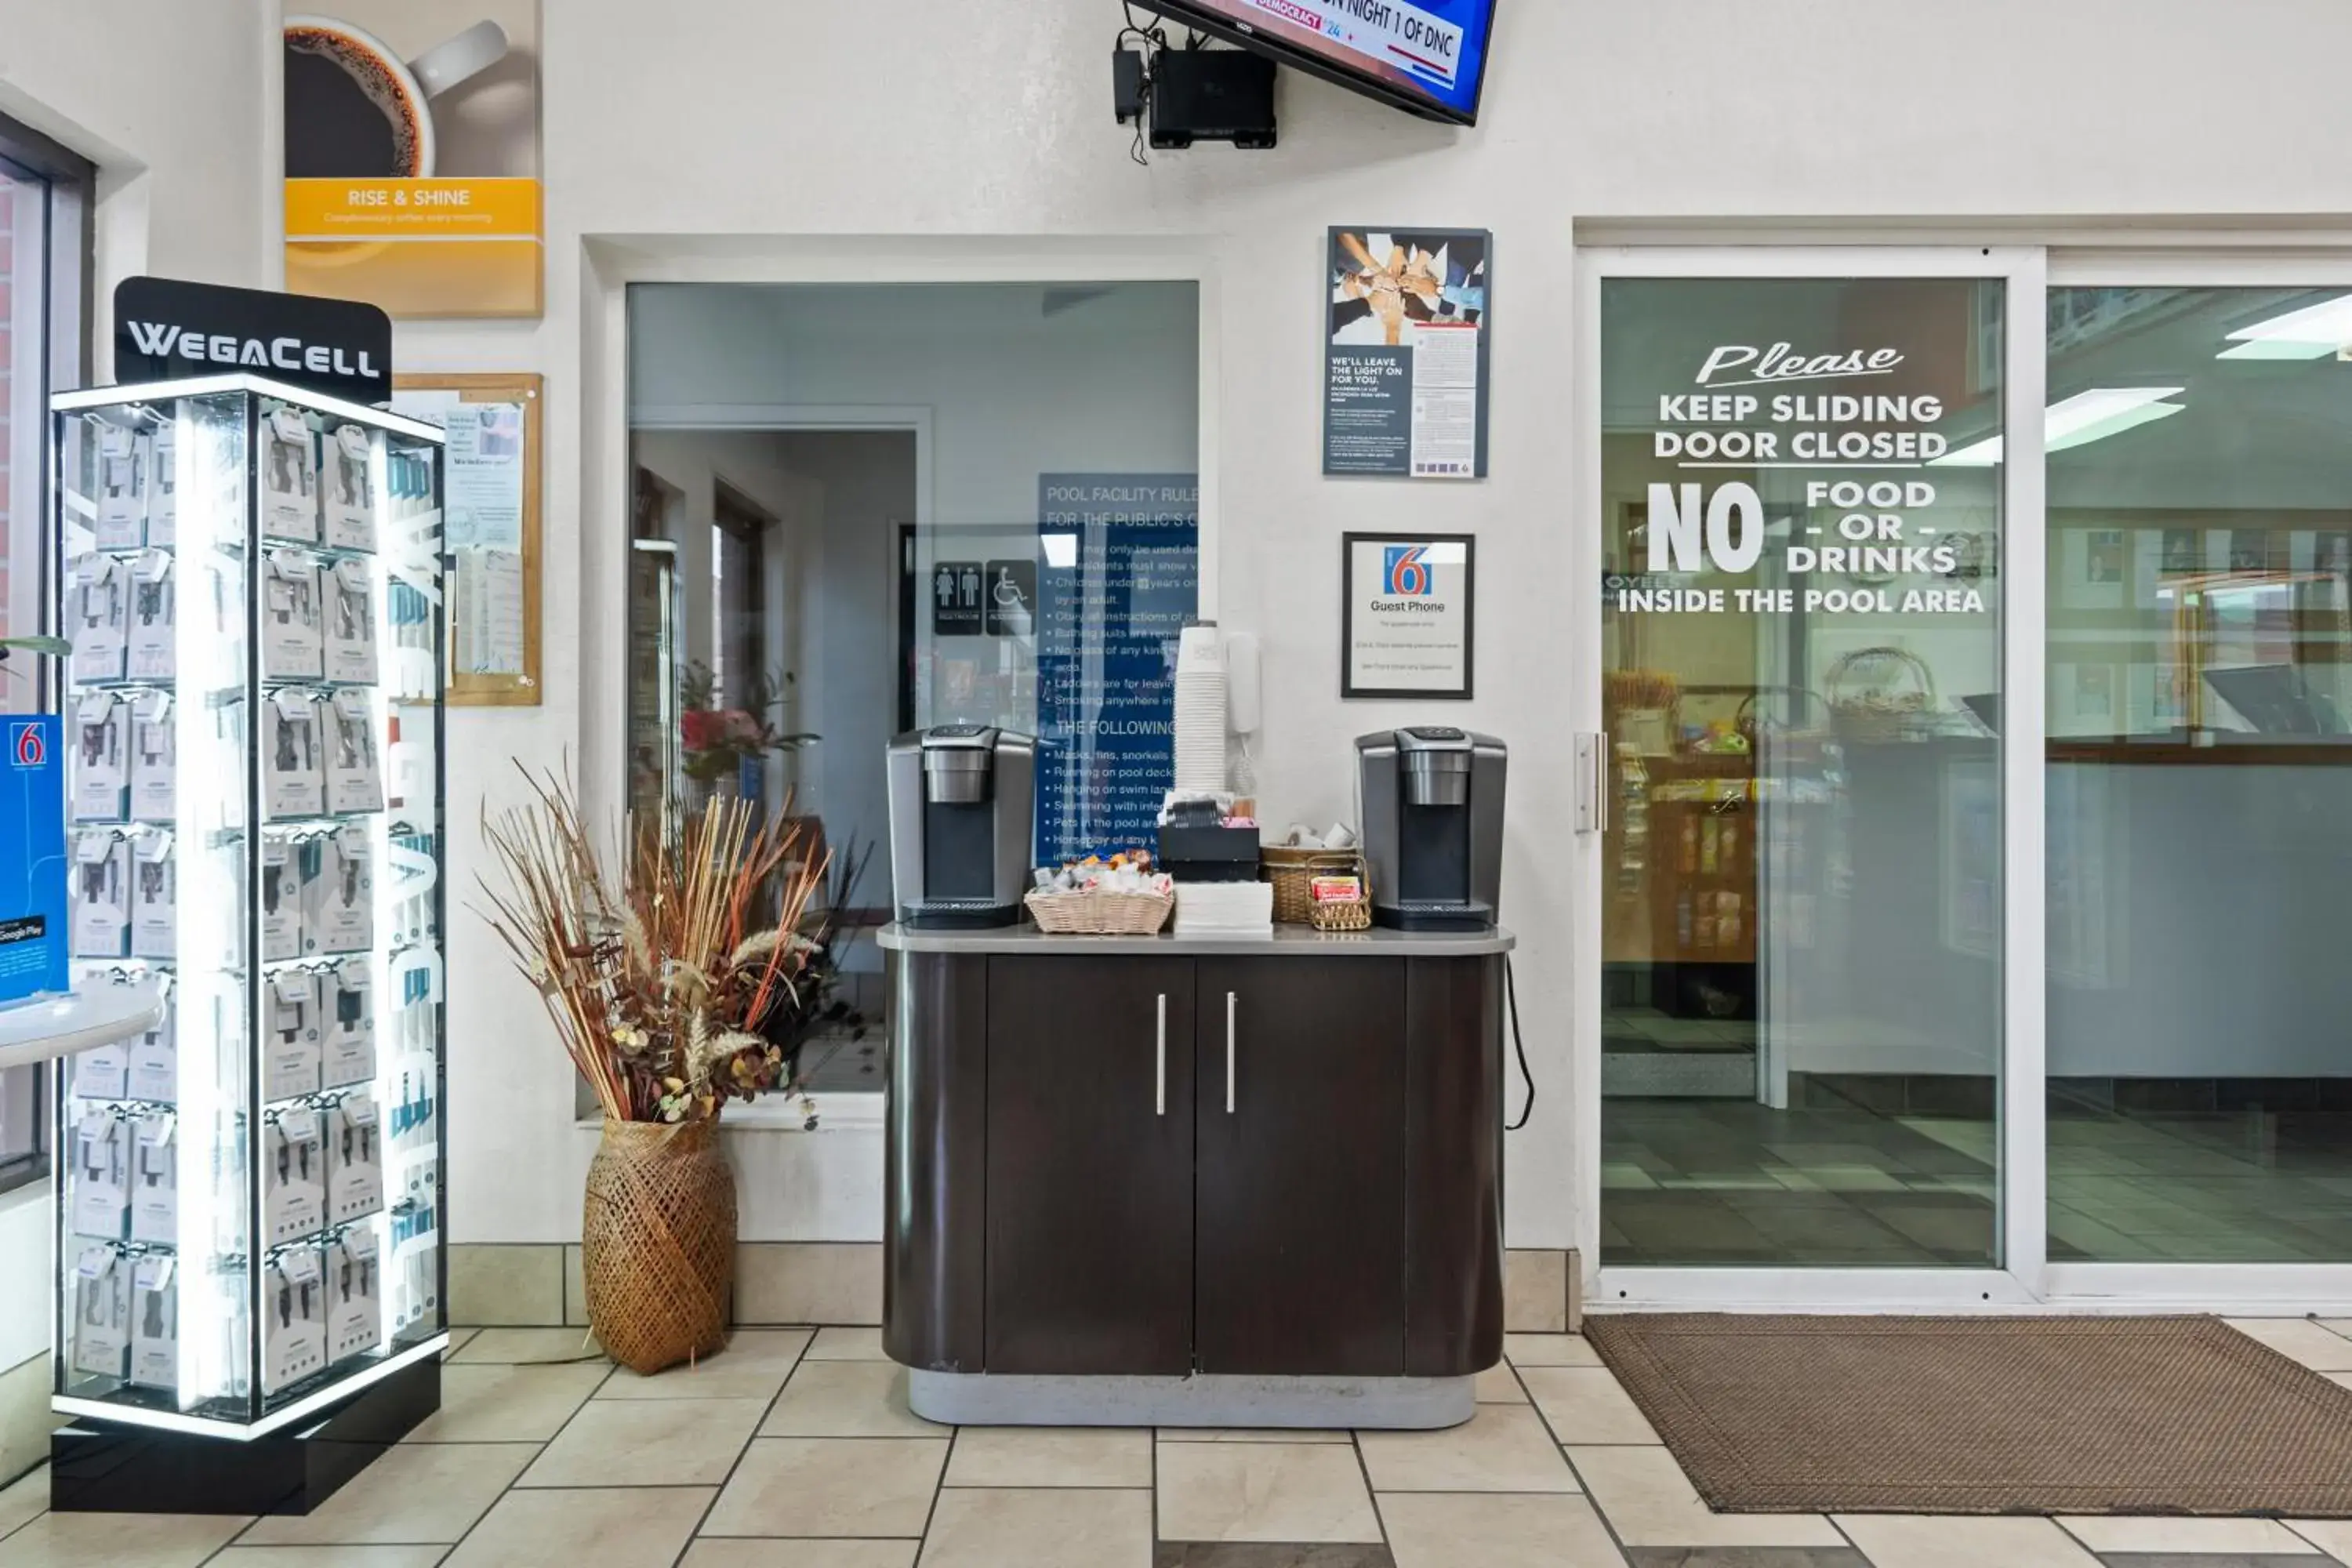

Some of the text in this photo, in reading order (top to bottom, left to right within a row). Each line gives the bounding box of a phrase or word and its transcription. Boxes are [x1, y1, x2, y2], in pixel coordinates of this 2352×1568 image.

[1345, 0, 1392, 29] NIGHT
[1394, 12, 1401, 34] 1
[1404, 17, 1424, 42] OF
[1425, 26, 1454, 57] DNC
[348, 190, 470, 206] RISE & SHINE
[1331, 357, 1396, 366] WE'LL LEAVE
[1695, 342, 1904, 384] Please
[1332, 366, 1403, 376] THE LIGHT ON
[1659, 394, 1944, 423] KEEP SLIDING
[1655, 432, 1947, 459] DOOR CLOSED
[1047, 487, 1199, 502] POOL FACILITY RULE
[1047, 512, 1077, 526] FOR
[1083, 512, 1112, 527] THE
[1116, 512, 1184, 527] PUBLIC'S
[1647, 481, 1936, 573] NO FOOD
[1839, 514, 1904, 540] OR
[1787, 546, 1956, 574] DRINKS
[1370, 601, 1445, 612] Guest Phone
[1619, 589, 1985, 612] INSIDE THE POOL AREA
[1142, 678, 1174, 688] leavin
[1057, 720, 1086, 735] THE
[17, 724, 45, 764] 6
[1119, 768, 1142, 779] pool
[1119, 785, 1149, 794] swim
[1114, 801, 1137, 811] with
[1094, 818, 1112, 827] the
[1114, 818, 1139, 829] pool
